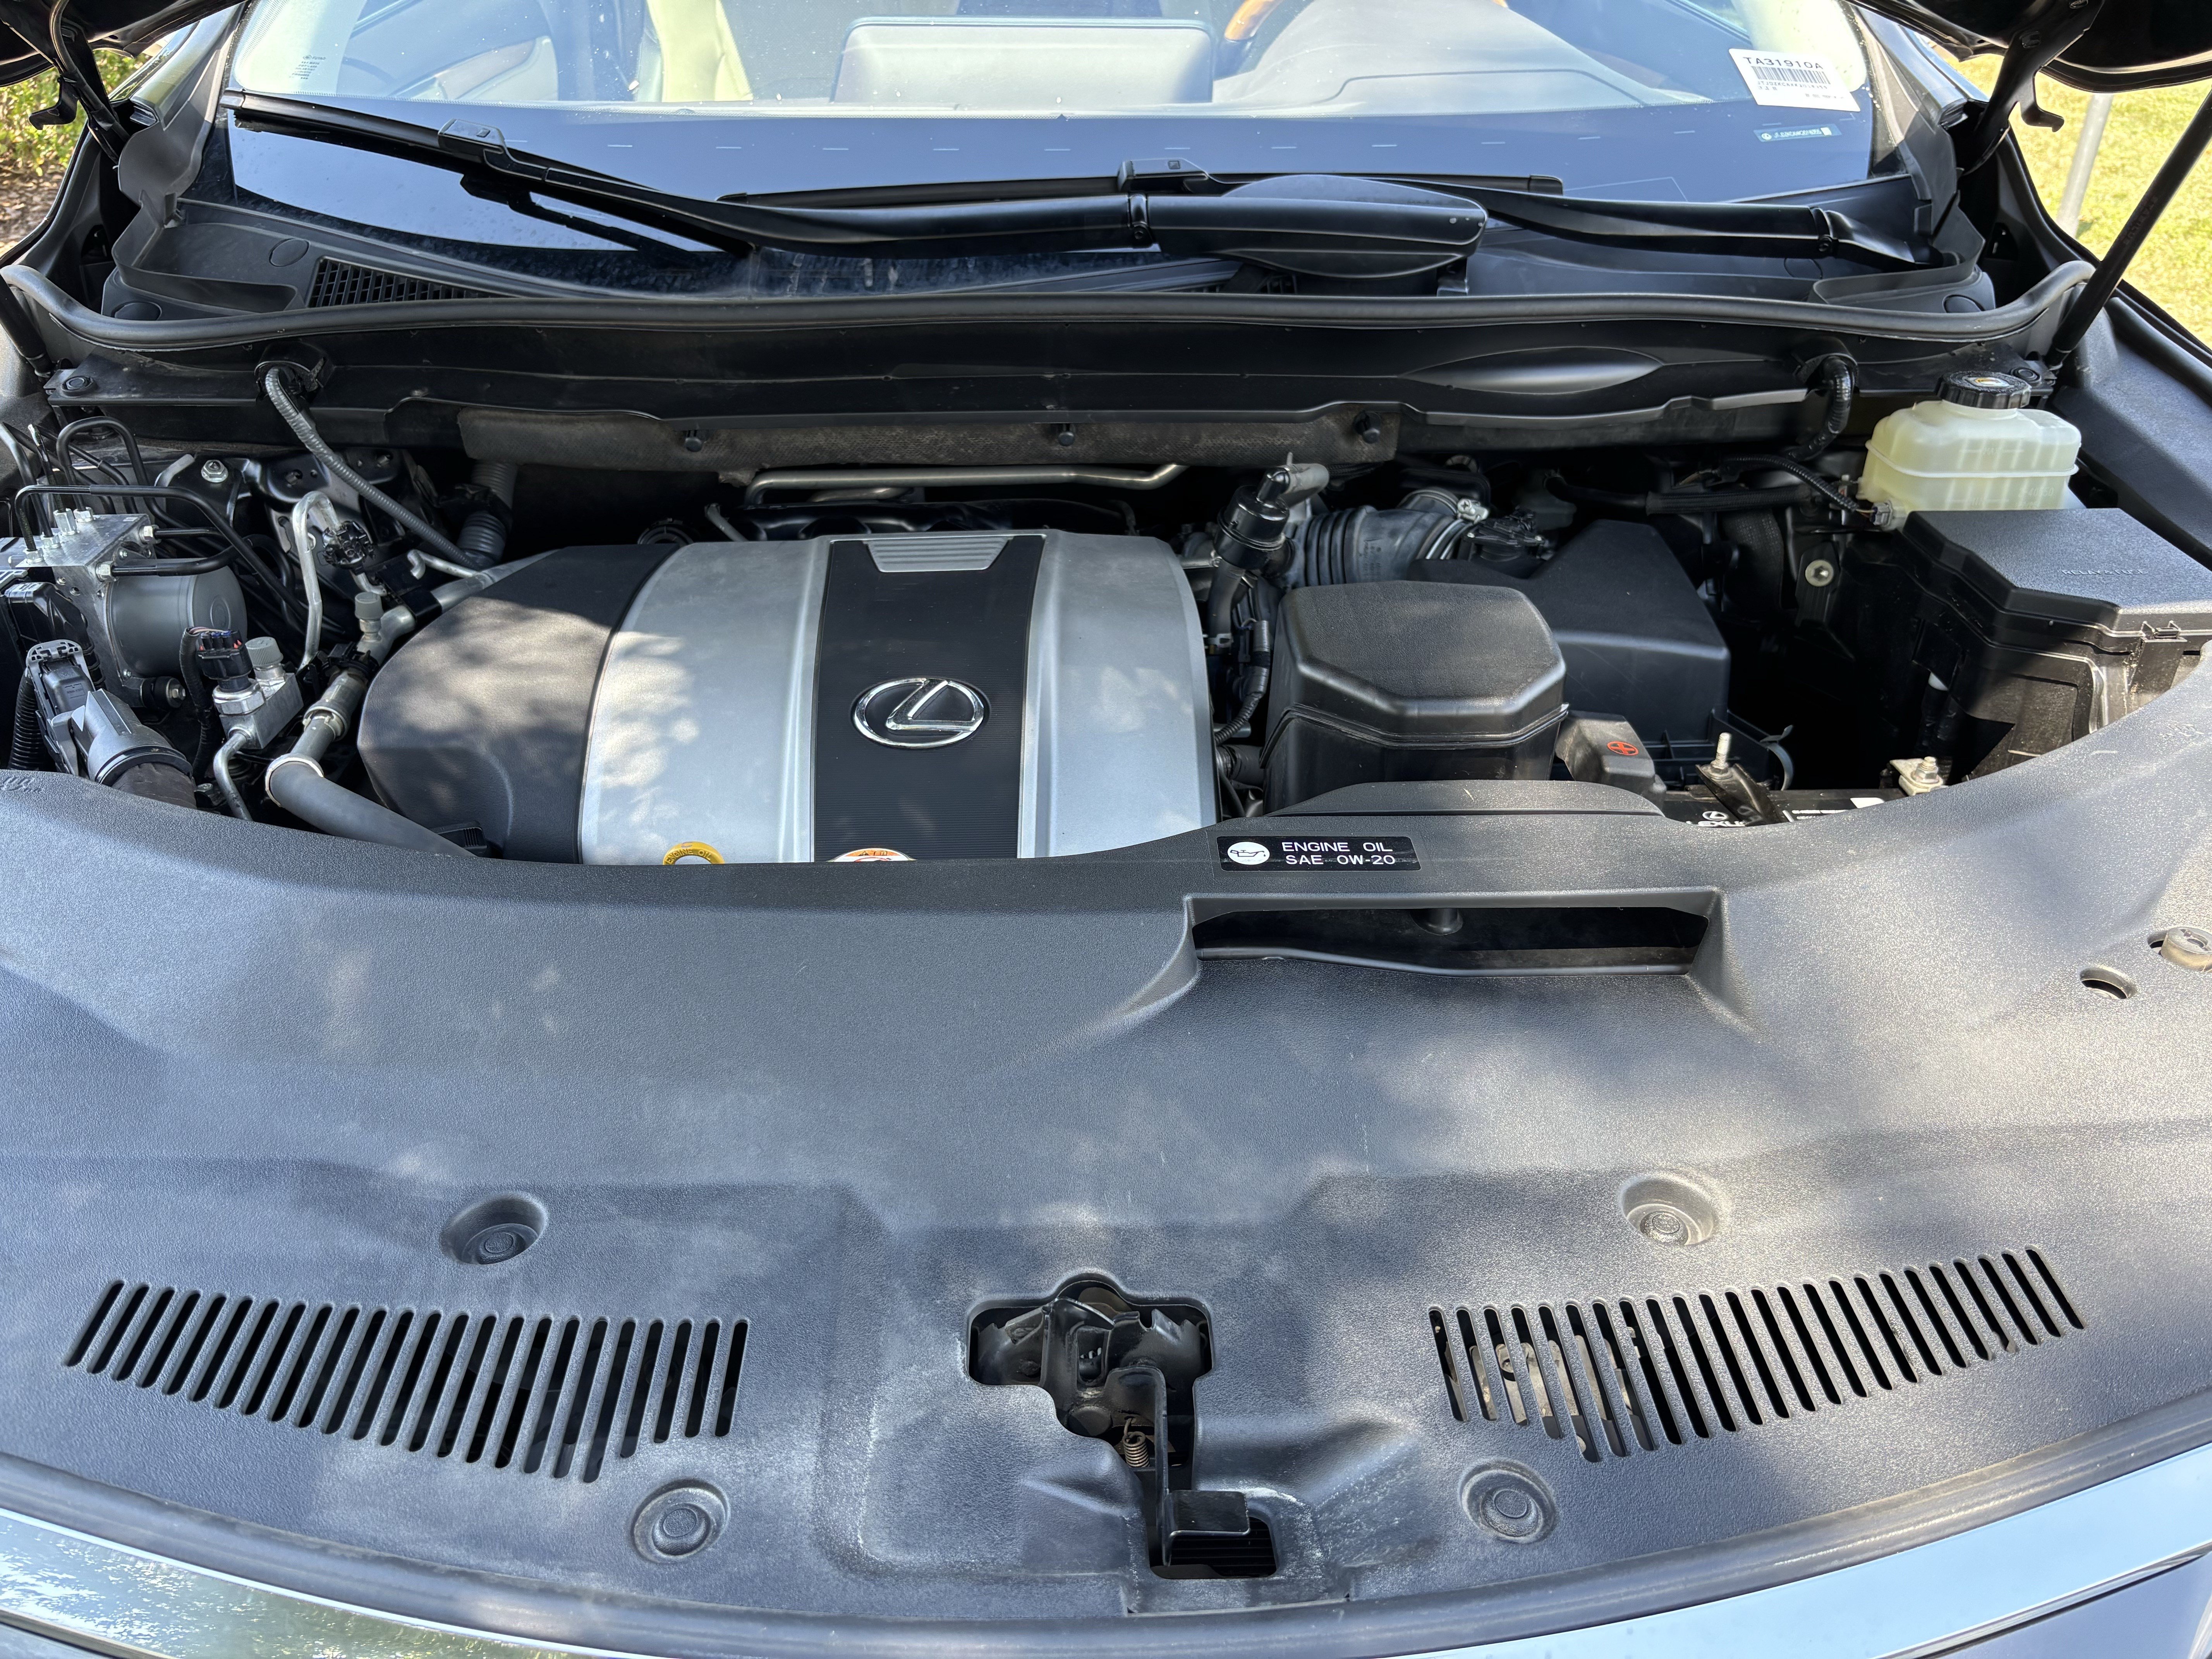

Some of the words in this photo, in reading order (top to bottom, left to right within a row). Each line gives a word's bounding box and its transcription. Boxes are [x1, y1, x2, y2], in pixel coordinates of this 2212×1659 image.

[1743, 57, 1823, 69] TA31910A
[1282, 842, 1350, 852] ENGINE
[1363, 842, 1393, 852] OIL
[666, 848, 693, 864] ENGINE
[698, 850, 711, 860] OIL
[1286, 855, 1324, 865] SAE
[1337, 855, 1395, 865] 0W-20
